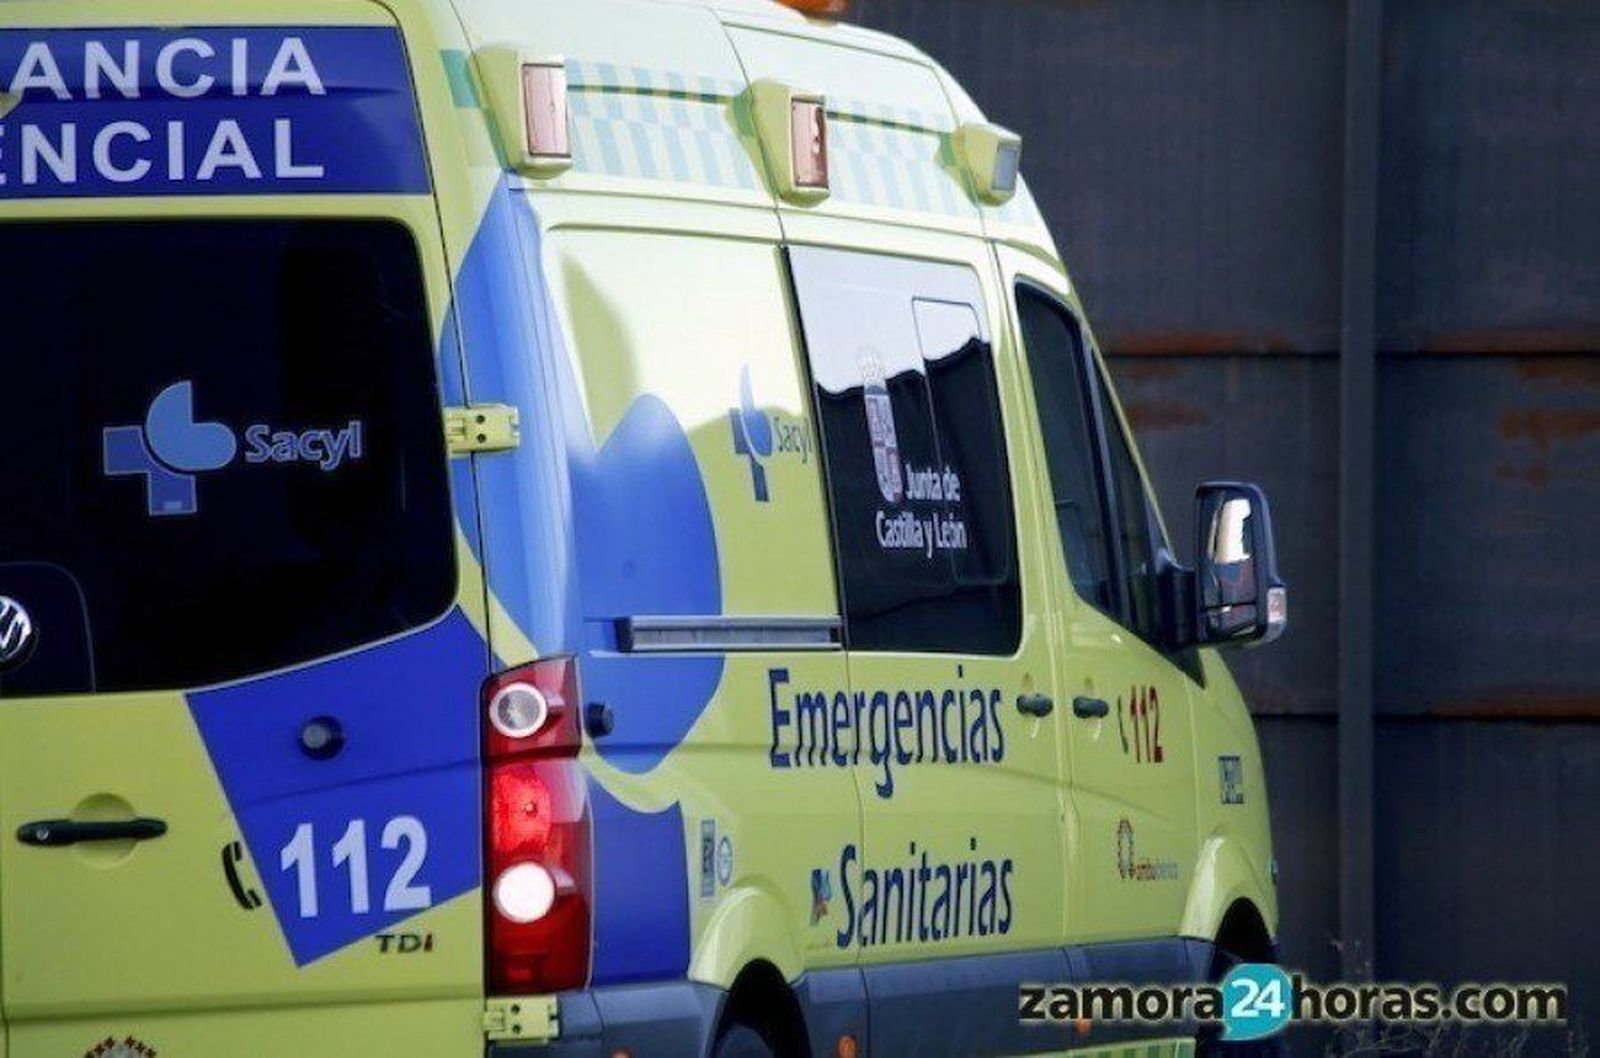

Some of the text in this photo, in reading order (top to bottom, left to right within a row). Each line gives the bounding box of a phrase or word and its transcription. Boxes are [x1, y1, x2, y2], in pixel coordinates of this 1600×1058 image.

[0, 119, 325, 185] NCIAL
[244, 420, 363, 471] Sacyl
[905, 464, 961, 501] Junta de
[875, 510, 968, 559] Castilla y León
[768, 664, 1005, 798] Emergencias
[1129, 686, 1163, 763] 112
[280, 815, 432, 918] 112
[836, 836, 1013, 948] Sanitarias
[375, 933, 434, 953] TDI
